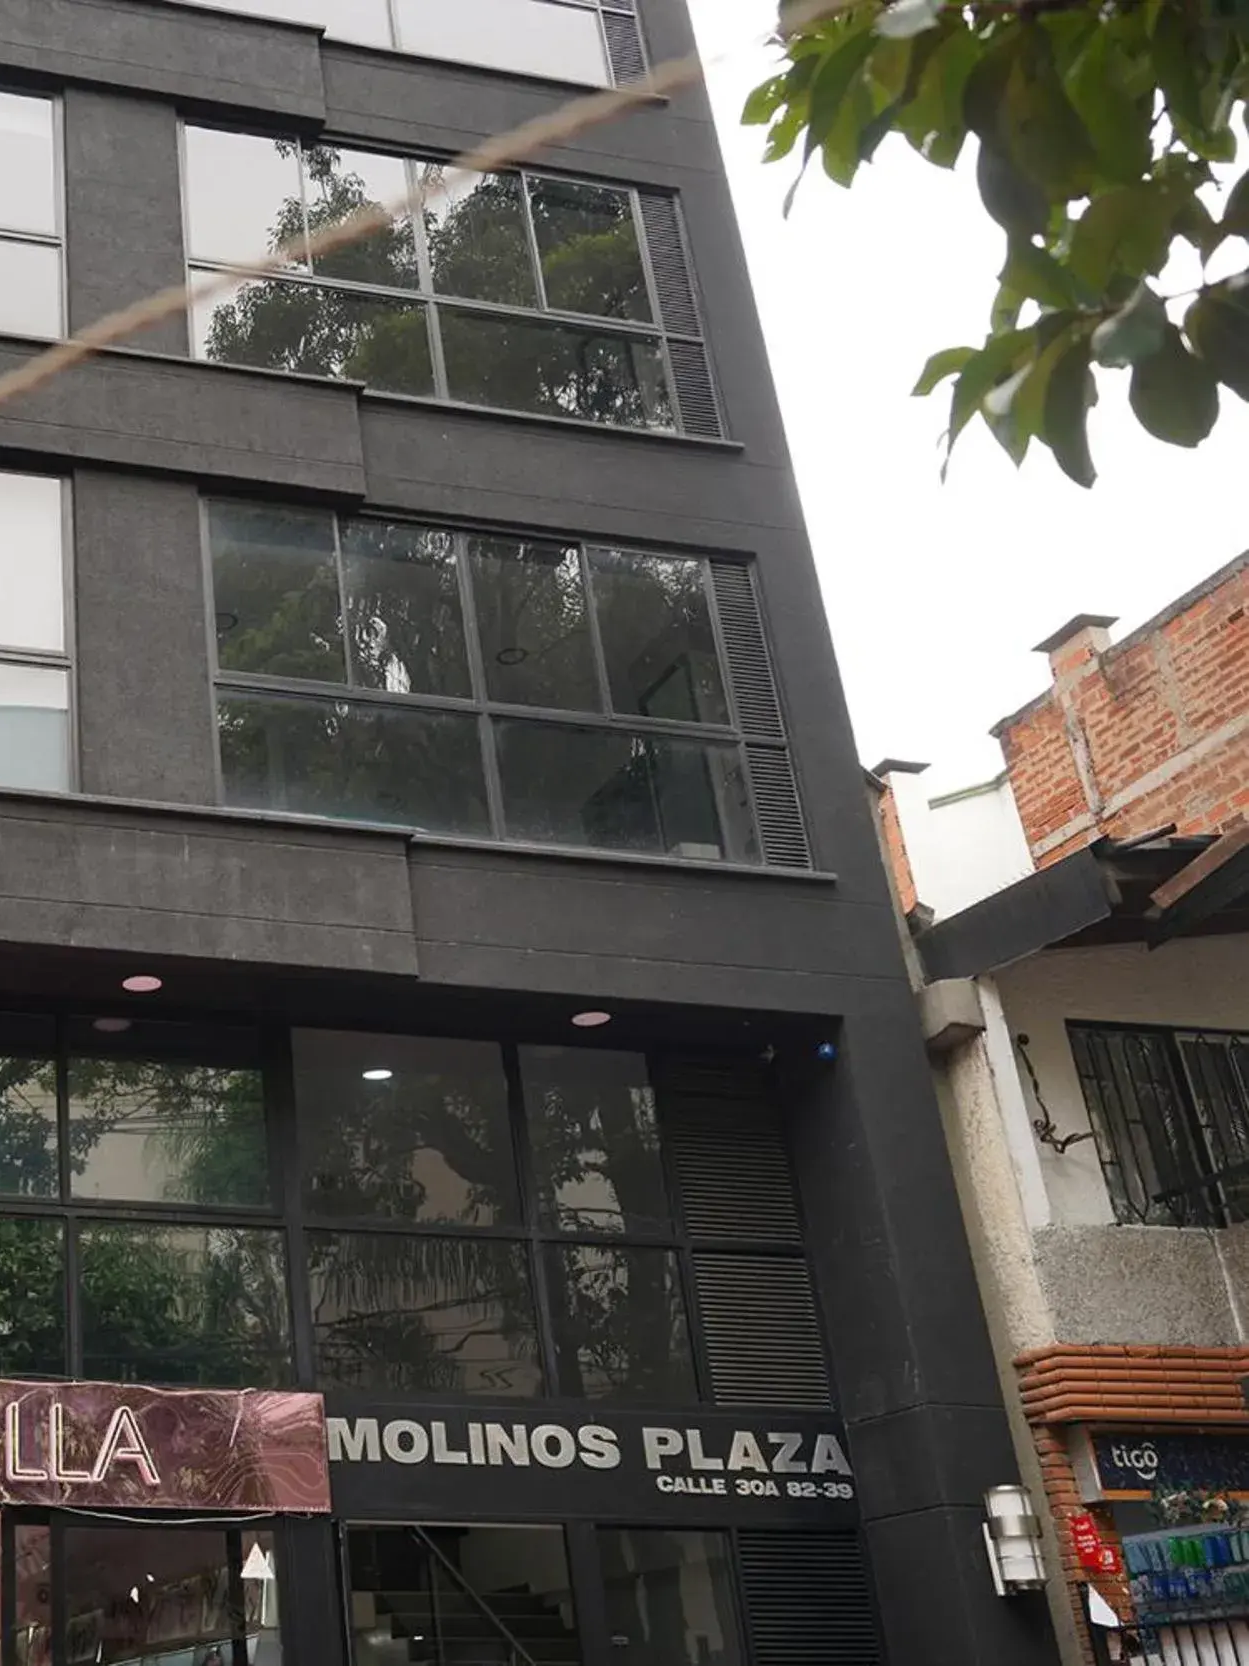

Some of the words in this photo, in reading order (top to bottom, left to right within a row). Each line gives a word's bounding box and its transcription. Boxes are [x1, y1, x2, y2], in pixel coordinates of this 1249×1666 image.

[327, 1417, 622, 1470] MOLINOS
[642, 1426, 853, 1476] PLAZA
[656, 1474, 727, 1496] CALLE
[735, 1478, 781, 1498] 30A
[786, 1482, 854, 1500] 82-39
